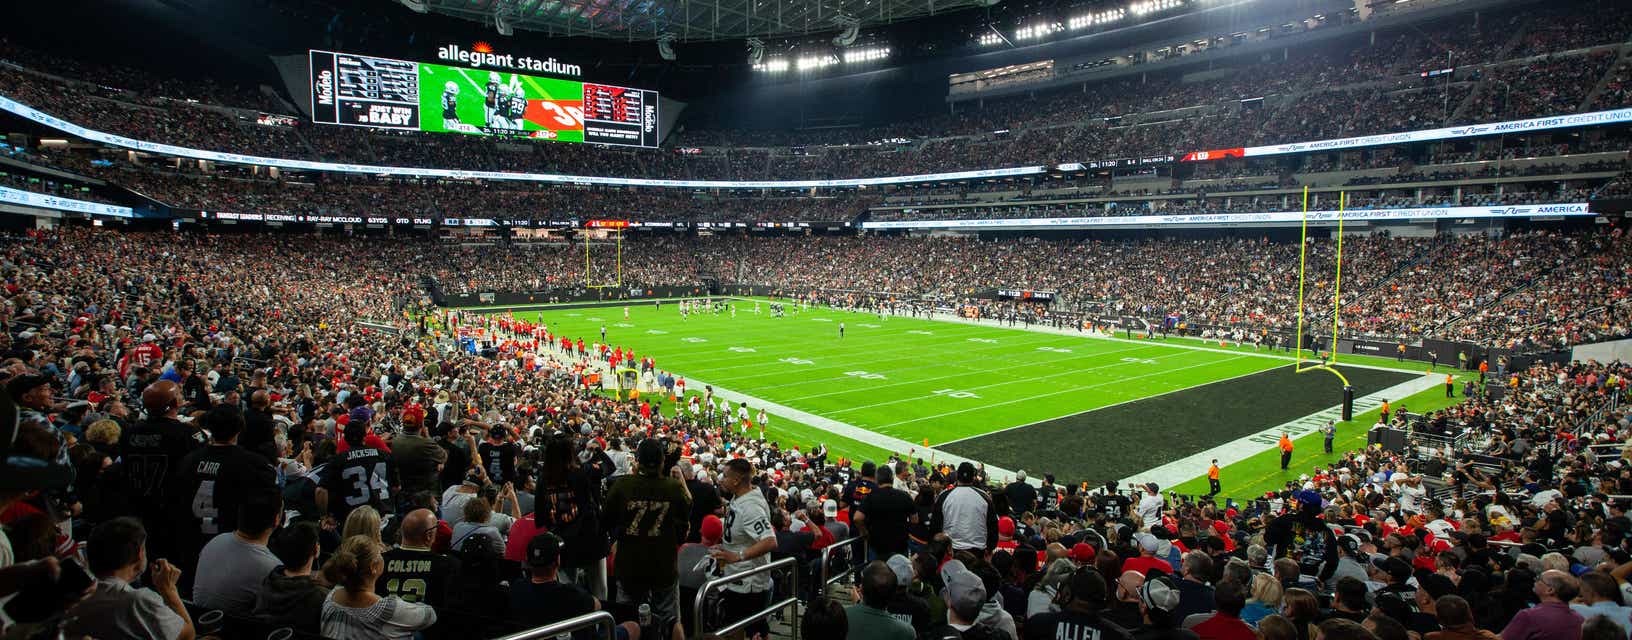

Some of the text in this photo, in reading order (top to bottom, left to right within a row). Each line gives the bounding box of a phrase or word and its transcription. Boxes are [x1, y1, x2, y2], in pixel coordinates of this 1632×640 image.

[438, 44, 581, 76] allegiant stadium
[317, 70, 333, 105] Modelo
[369, 111, 412, 125] BABY
[370, 105, 392, 114] JUST
[392, 106, 412, 116] WIN
[644, 105, 656, 133] Modelo
[1494, 121, 1535, 131] AMERICA
[1536, 118, 1564, 127] FIRST
[1566, 114, 1603, 124] CREDIT
[1309, 141, 1338, 149] AMERICA
[1338, 138, 1359, 146] FIRST
[1337, 211, 1369, 219] AMERICA
[1537, 203, 1584, 213] AMERICA
[138, 353, 151, 367] 15
[346, 448, 379, 461] JACKSON
[197, 460, 221, 475] CARR
[342, 462, 391, 506] 34
[192, 480, 220, 534] 4
[625, 500, 671, 536] 77
[387, 559, 432, 573] COLSTON
[386, 578, 427, 602] 12
[1055, 621, 1102, 640] ALLEN
